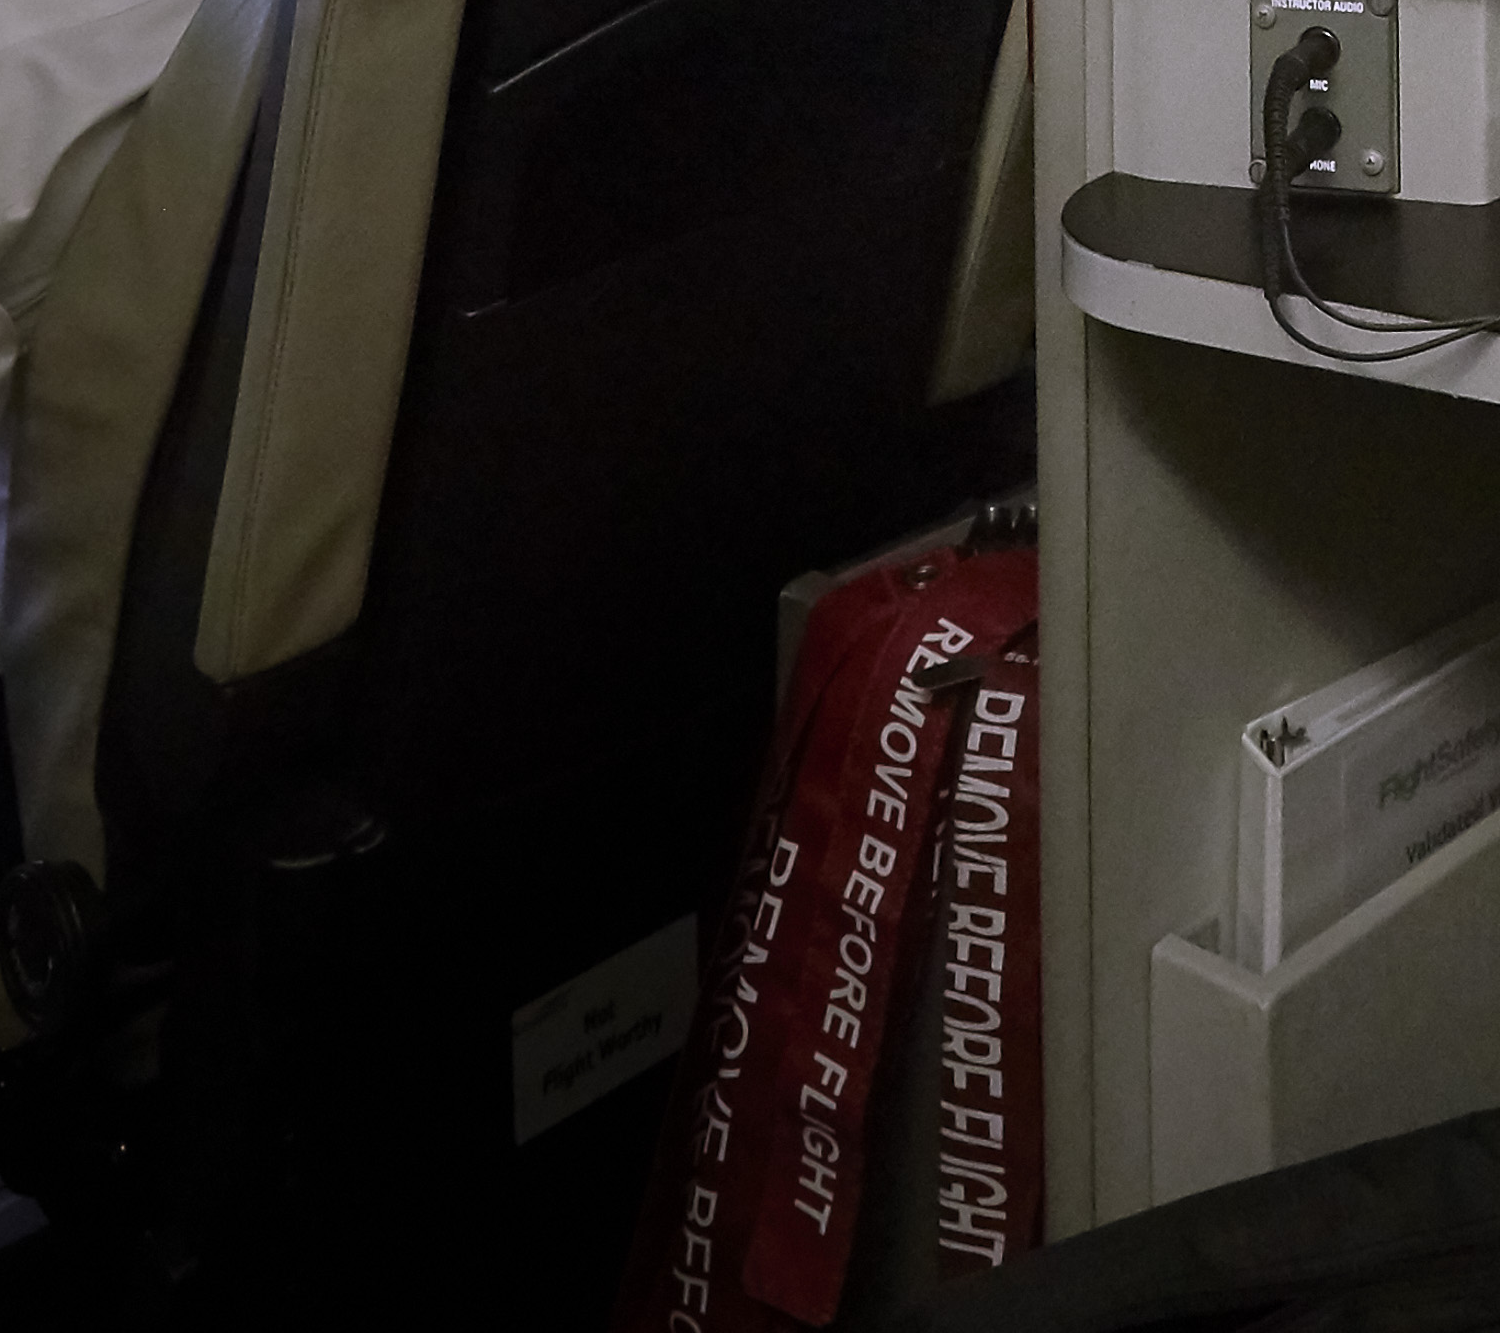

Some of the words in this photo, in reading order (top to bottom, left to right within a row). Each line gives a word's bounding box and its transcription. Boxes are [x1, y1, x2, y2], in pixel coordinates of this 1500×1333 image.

[1333, 2, 1364, 14] AUDIO
[1310, 79, 1329, 92] MIC
[823, 834, 897, 1048] BEFORE
[794, 1051, 848, 1235] FLIGHT
